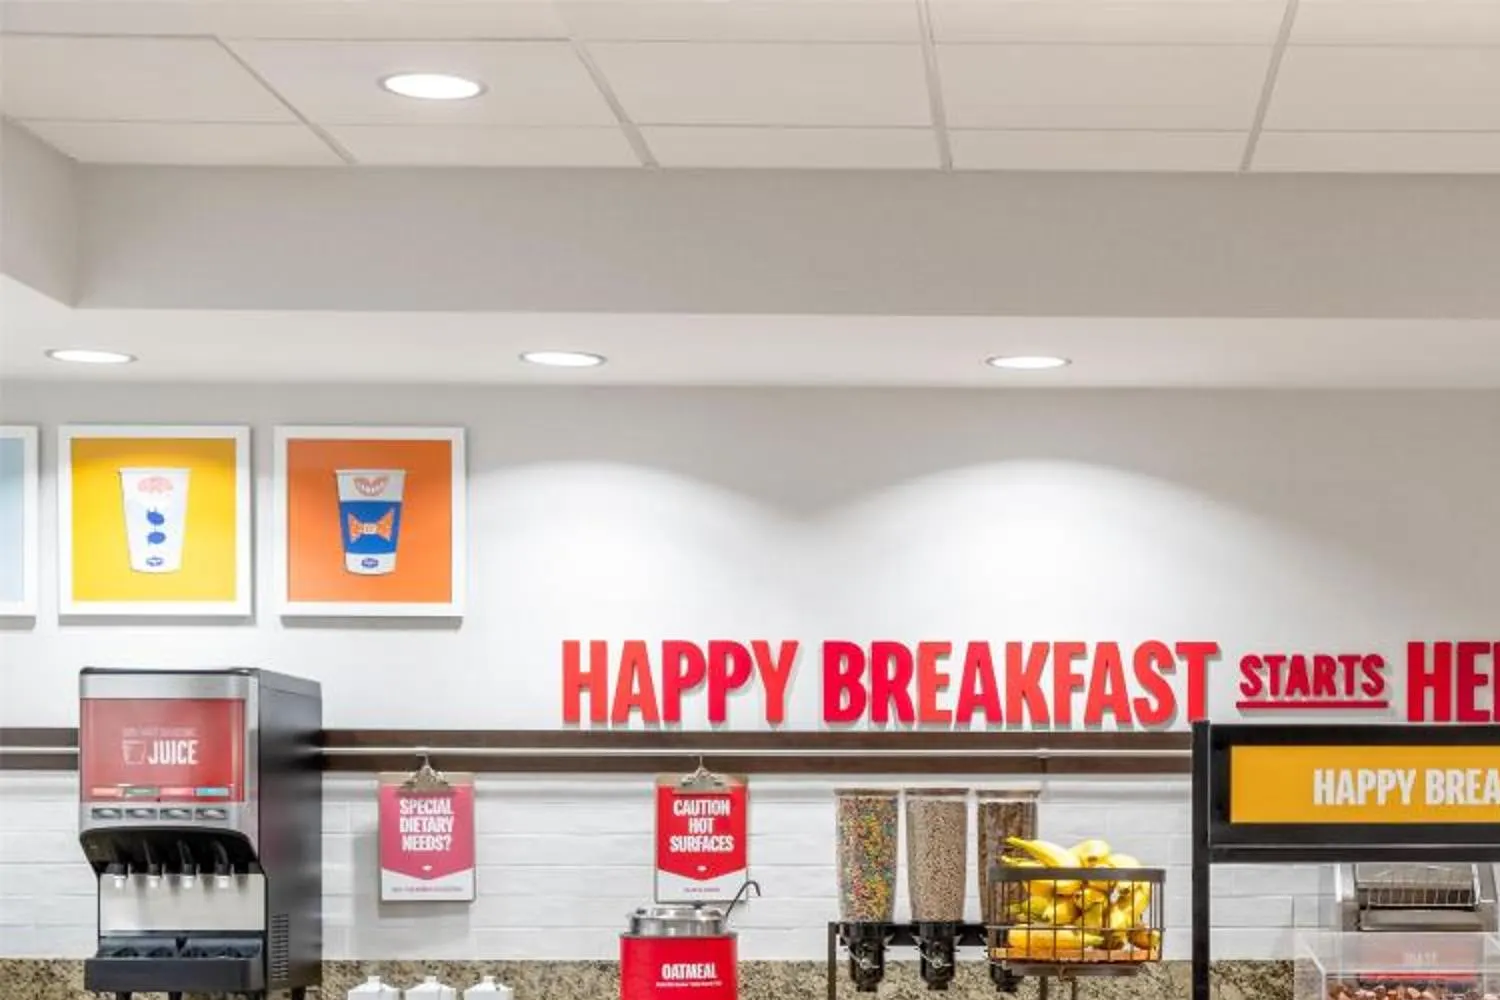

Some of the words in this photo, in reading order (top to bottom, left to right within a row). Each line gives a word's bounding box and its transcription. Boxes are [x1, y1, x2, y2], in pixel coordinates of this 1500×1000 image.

[562, 640, 799, 725] HAPPY
[823, 641, 1218, 725] BREAKFAST
[1238, 653, 1386, 698] STARTS
[148, 739, 199, 765] JUICE
[1313, 768, 1416, 806] HAPPY
[400, 798, 454, 815] SPECIAL
[673, 799, 731, 816] CAUTION
[400, 815, 454, 832] DIETARY
[688, 817, 715, 834] HOT
[402, 834, 452, 851] NEEDS?
[669, 835, 734, 852] SURFACES
[661, 962, 717, 980] OATMEAL
